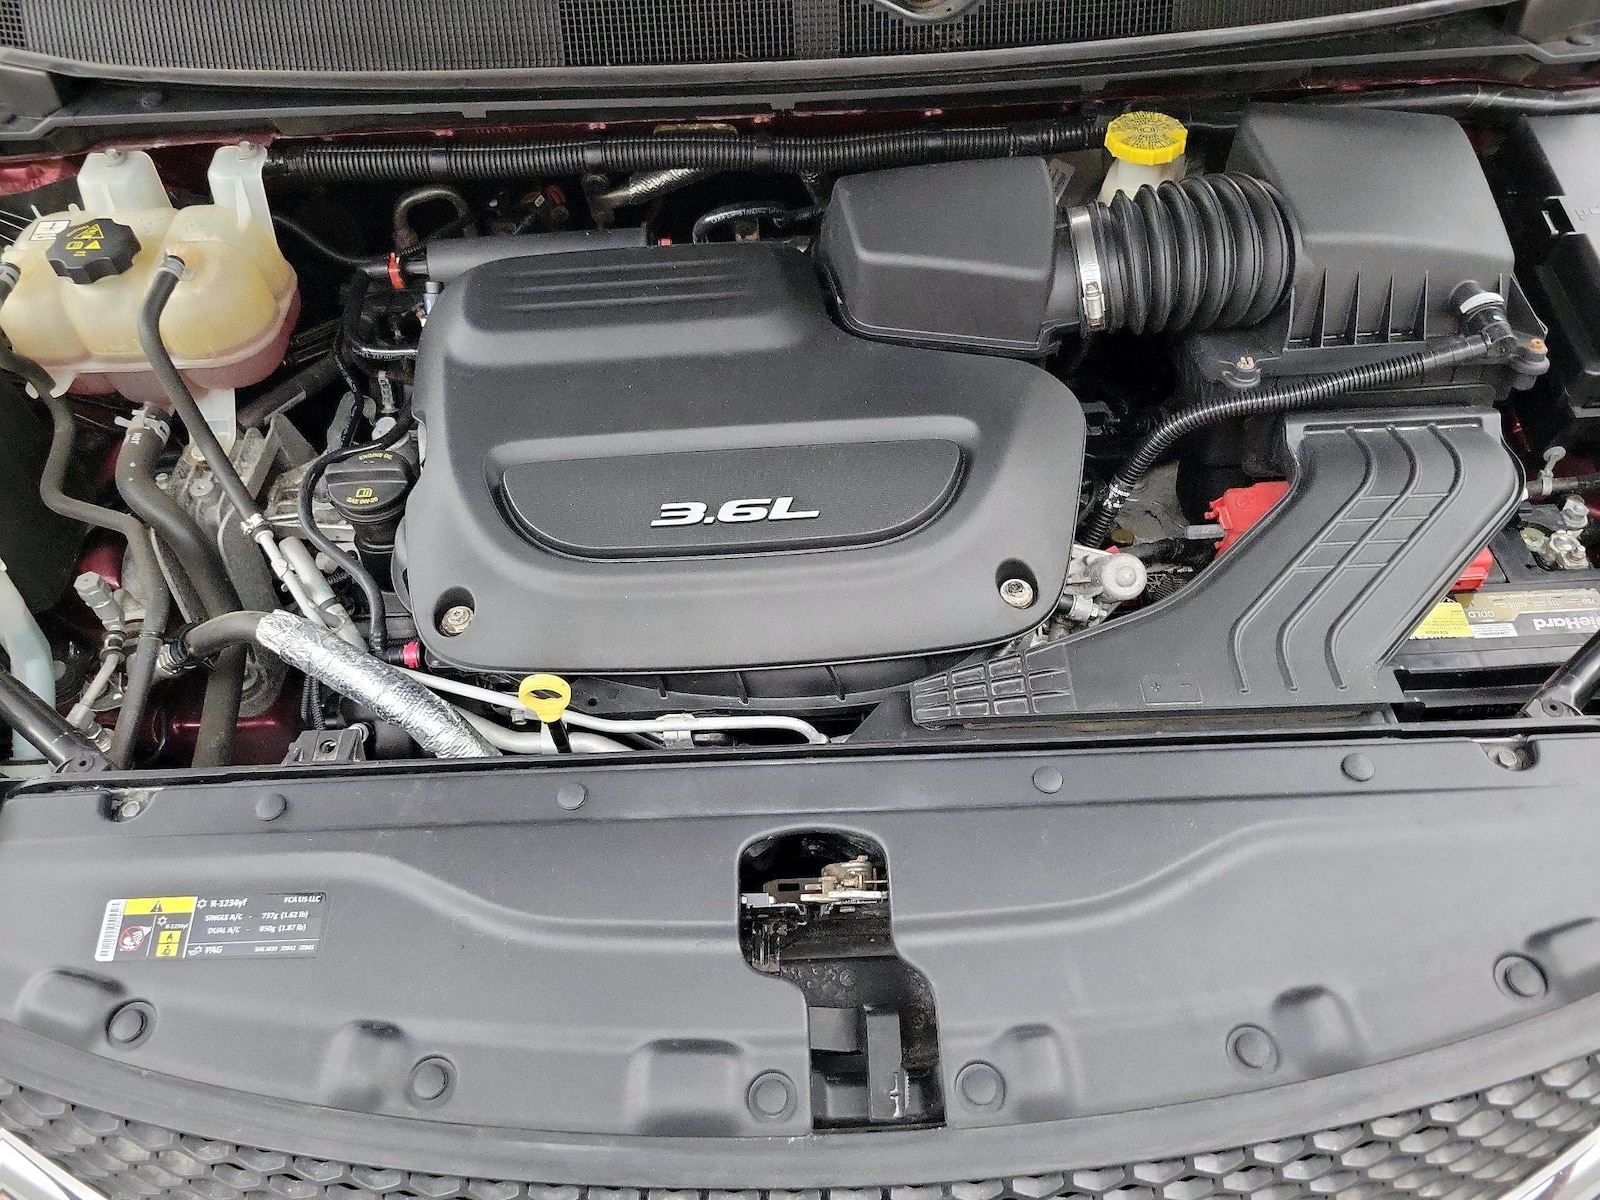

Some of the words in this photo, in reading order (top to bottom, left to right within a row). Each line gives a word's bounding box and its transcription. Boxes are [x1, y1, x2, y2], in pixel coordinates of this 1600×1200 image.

[358, 452, 383, 460] ENGINE
[650, 497, 820, 527] 3.6L
[210, 898, 248, 908] R-1234yf
[229, 913, 243, 921] A/C
[261, 912, 279, 920] 737g
[280, 911, 298, 919] (1.62
[298, 911, 309, 919] lb)
[227, 925, 241, 934] A/C
[259, 925, 276, 933] 850g
[278, 925, 295, 933] (1.87
[296, 924, 306, 932] lb)
[204, 946, 223, 954] PAG
